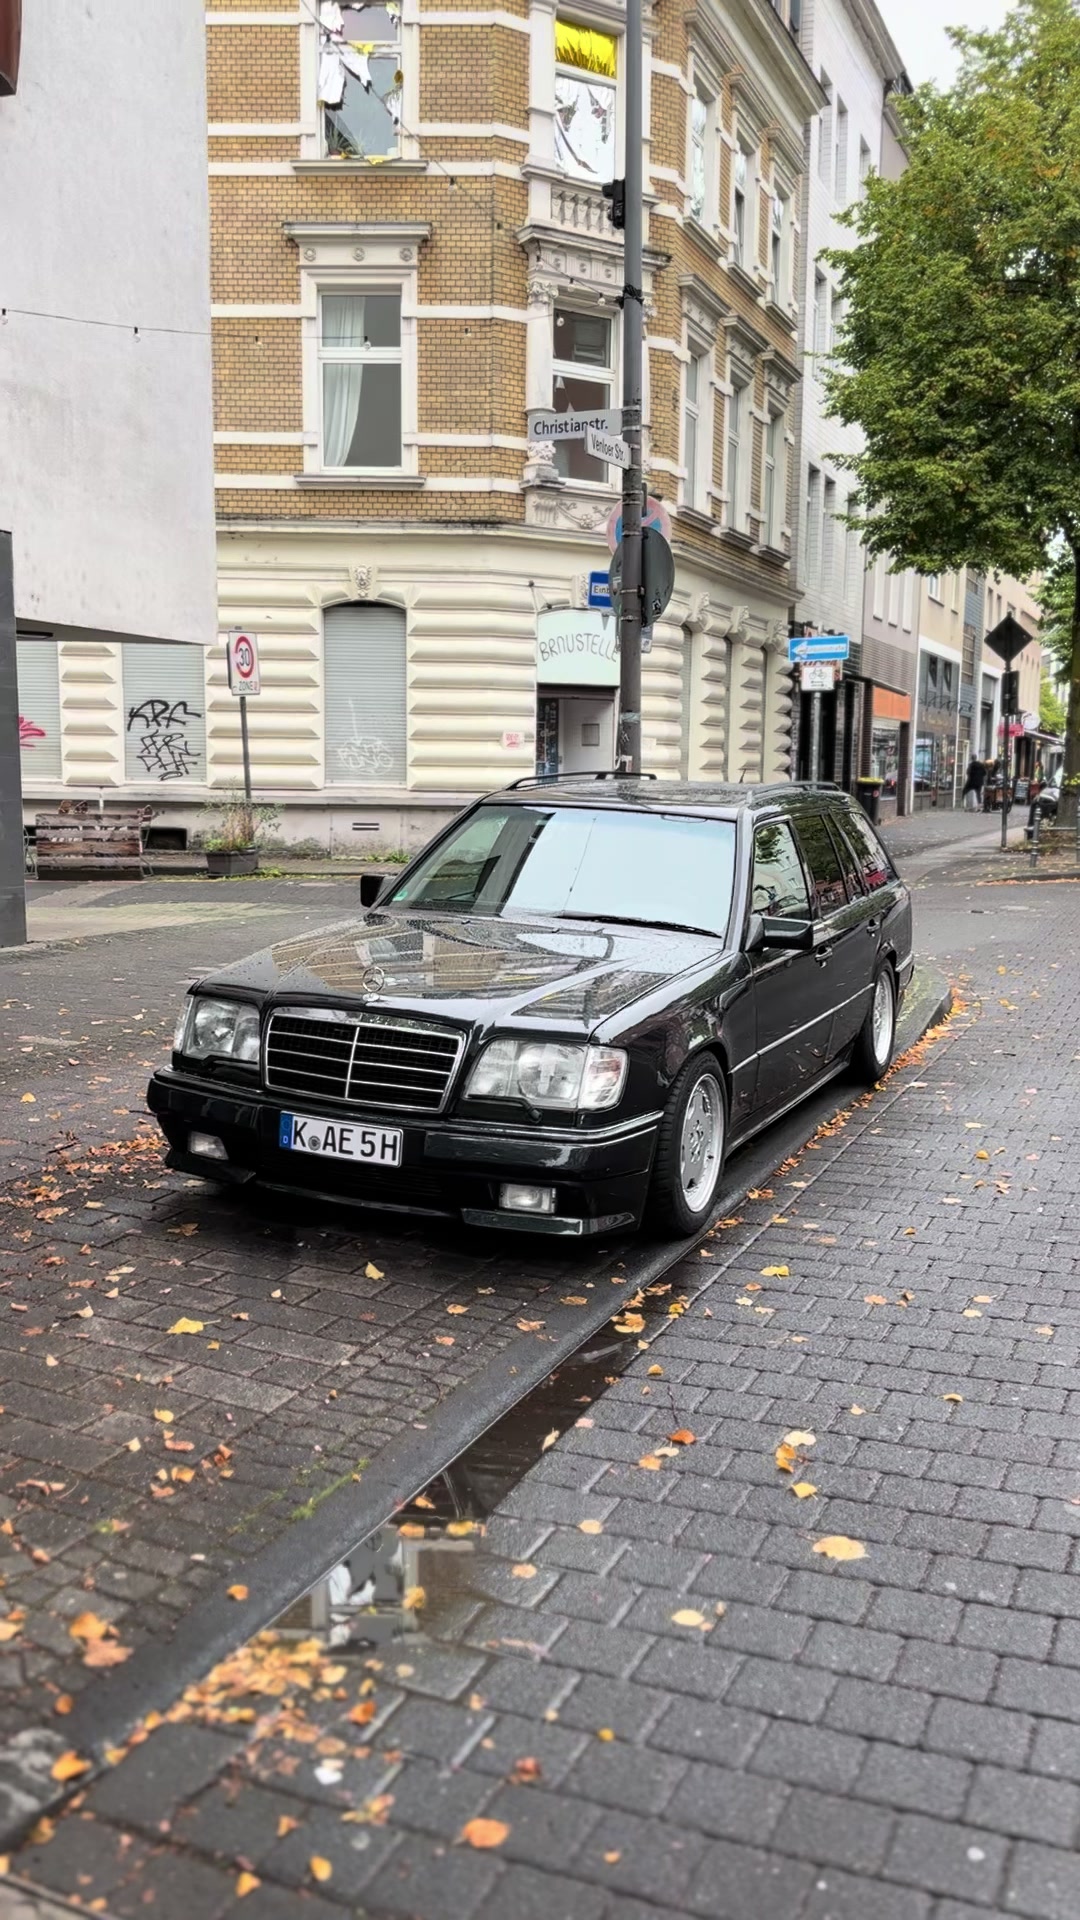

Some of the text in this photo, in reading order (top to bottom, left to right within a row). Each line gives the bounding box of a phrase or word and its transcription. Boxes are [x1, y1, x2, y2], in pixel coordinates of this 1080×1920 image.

[533, 418, 609, 435] Christianstr.
[591, 433, 626, 461] Venloer Str.
[239, 648, 250, 666] 30
[539, 633, 618, 663] BRAUSTELLE
[239, 681, 253, 691] ZONE
[283, 1136, 288, 1144] D
[293, 1120, 308, 1147] K
